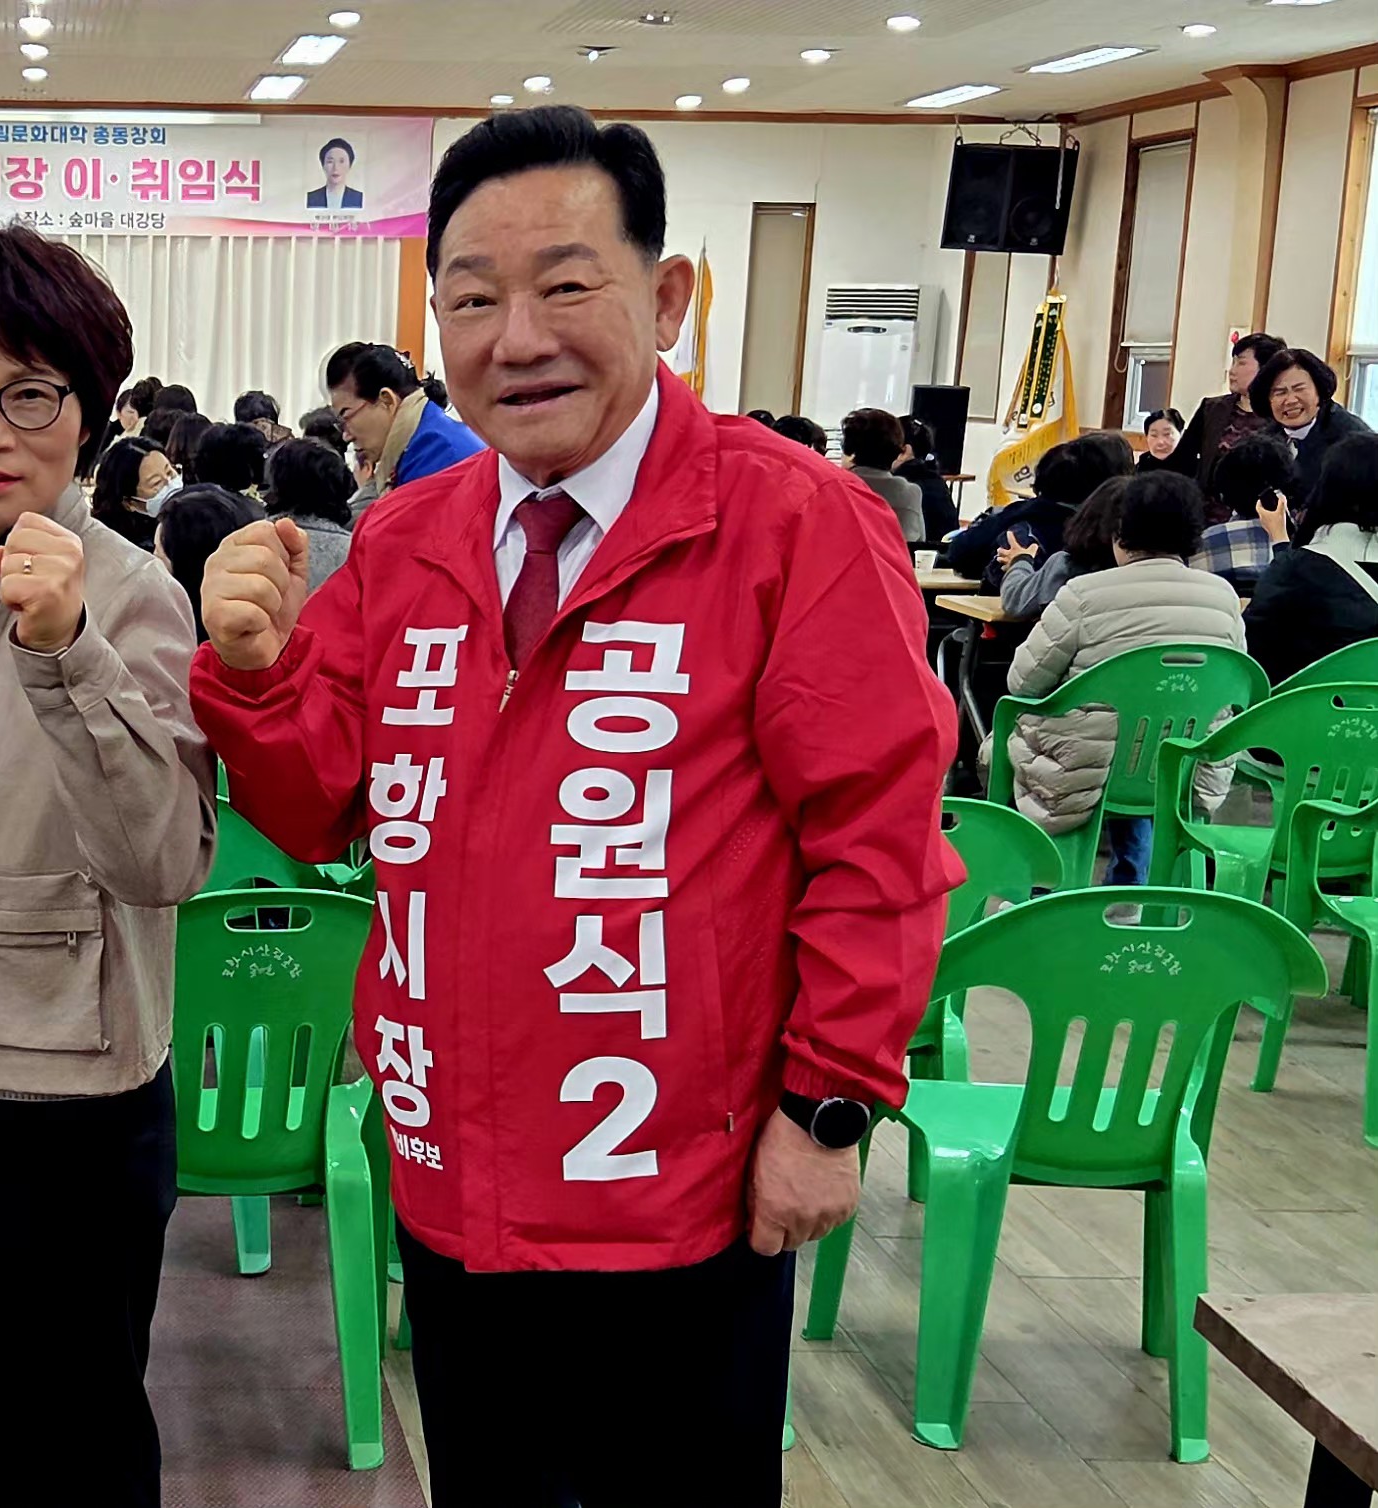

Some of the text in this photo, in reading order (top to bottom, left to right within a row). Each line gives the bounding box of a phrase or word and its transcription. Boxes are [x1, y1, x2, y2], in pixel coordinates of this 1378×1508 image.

[68, 211, 114, 228] 숲마을
[120, 212, 165, 229] 대강당
[92, 125, 167, 146] 총동창회
[369, 624, 468, 1128] 포항시장
[543, 620, 691, 1040] 공원식
